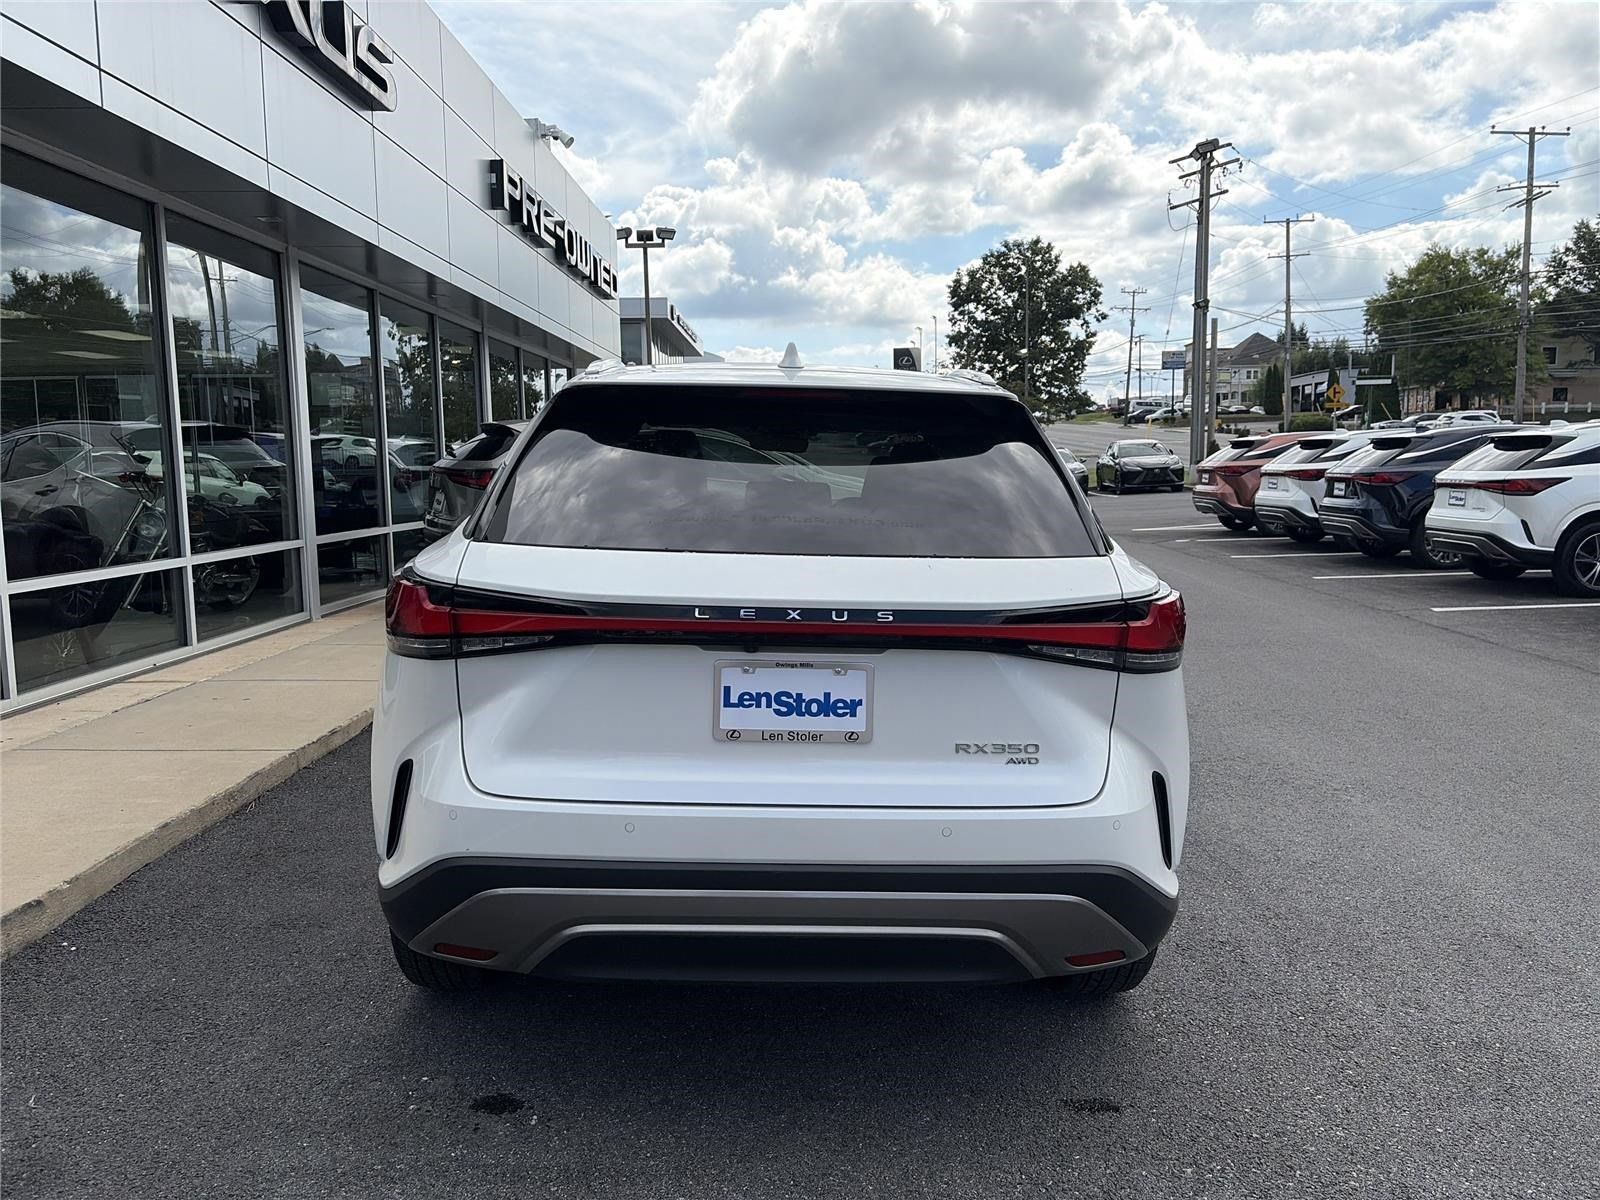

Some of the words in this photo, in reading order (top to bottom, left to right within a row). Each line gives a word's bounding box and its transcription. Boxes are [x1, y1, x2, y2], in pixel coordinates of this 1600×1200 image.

[502, 160, 619, 298] PRE-OWNED
[694, 608, 894, 622] LEXUS
[761, 730, 784, 741] Len
[787, 731, 824, 742] Stoler
[954, 743, 1040, 755] RX350
[1004, 757, 1040, 765] AWD
